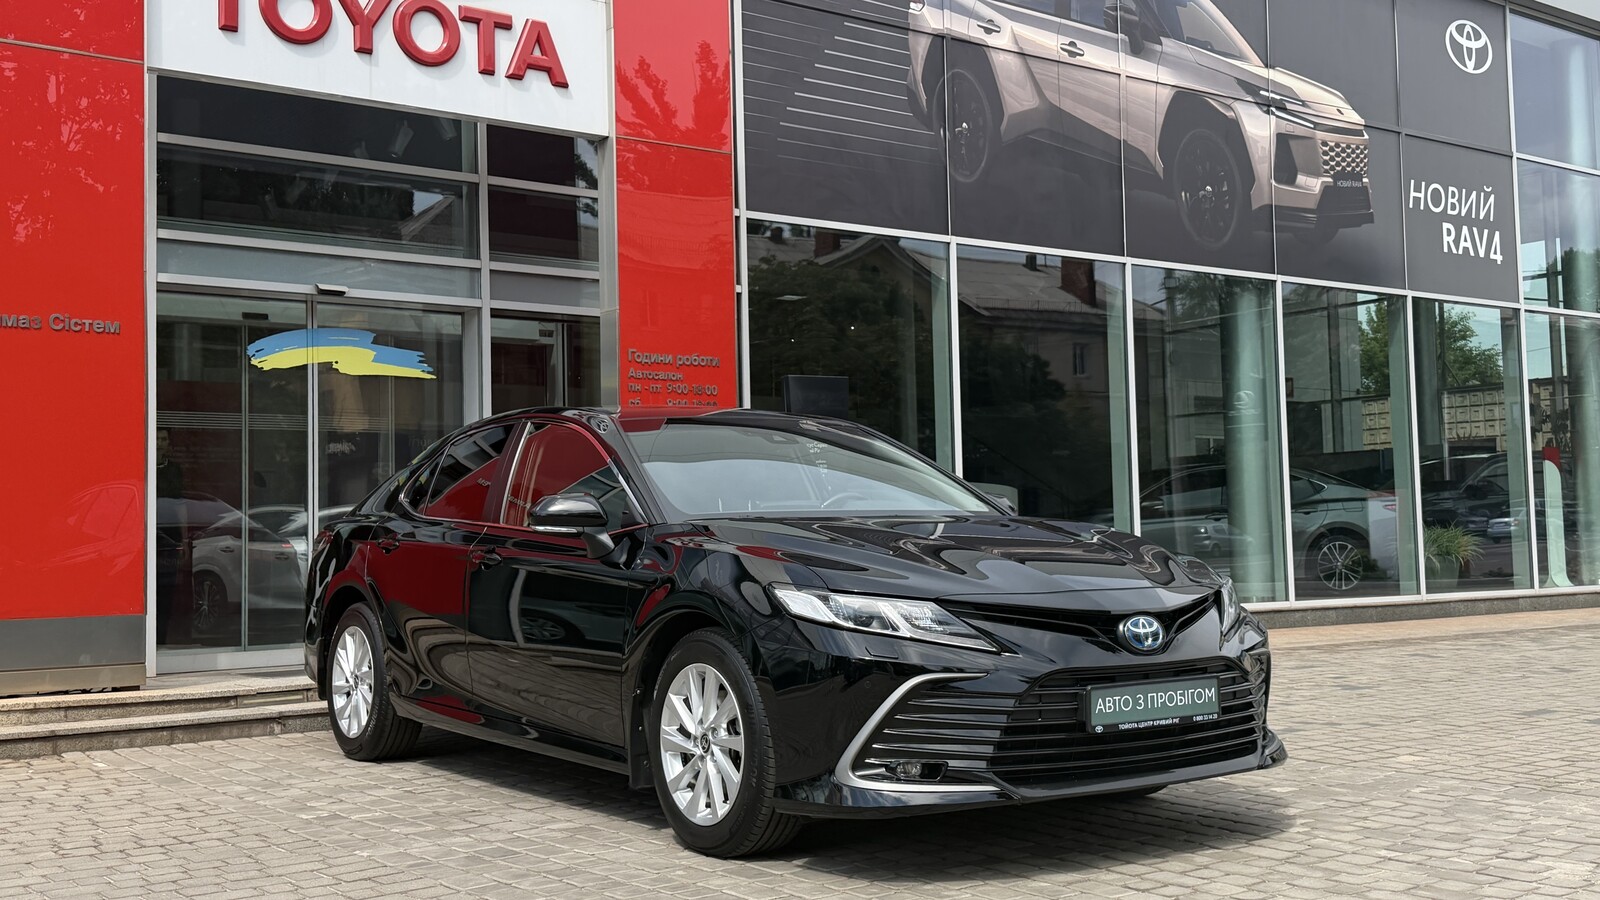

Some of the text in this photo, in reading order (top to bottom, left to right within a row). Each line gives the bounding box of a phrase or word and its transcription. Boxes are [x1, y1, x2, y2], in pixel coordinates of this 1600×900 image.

[1409, 179, 1495, 221] НОВИЙ
[1442, 222, 1503, 265] RAV4
[0, 313, 121, 334] маз Сістем
[628, 349, 720, 368] Години роботи
[628, 368, 683, 381] Автосалон
[628, 383, 641, 392] пн
[1095, 695, 1133, 714] АВТО
[1147, 687, 1216, 709] ПРОБІГОМ
